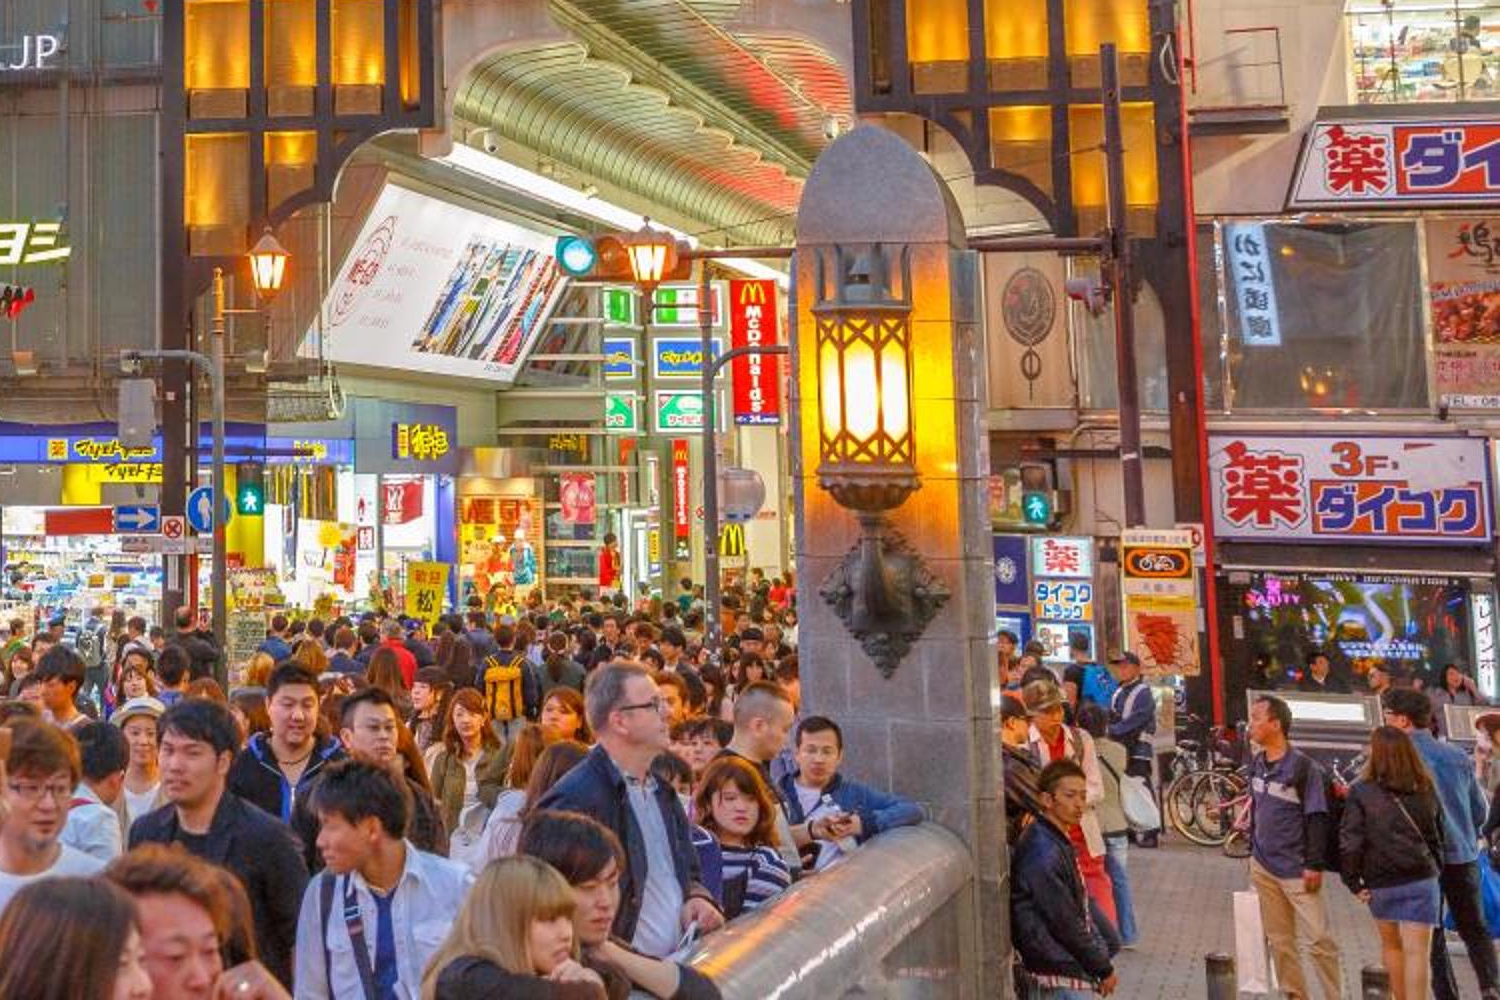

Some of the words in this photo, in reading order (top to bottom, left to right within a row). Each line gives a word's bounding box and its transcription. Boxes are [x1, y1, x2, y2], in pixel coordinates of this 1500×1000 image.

[1326, 124, 1388, 193] 薬
[745, 305, 765, 413] McDnald's
[1222, 440, 1302, 525] 薬
[1317, 485, 1479, 531] ダイコク
[416, 588, 437, 614] 松
